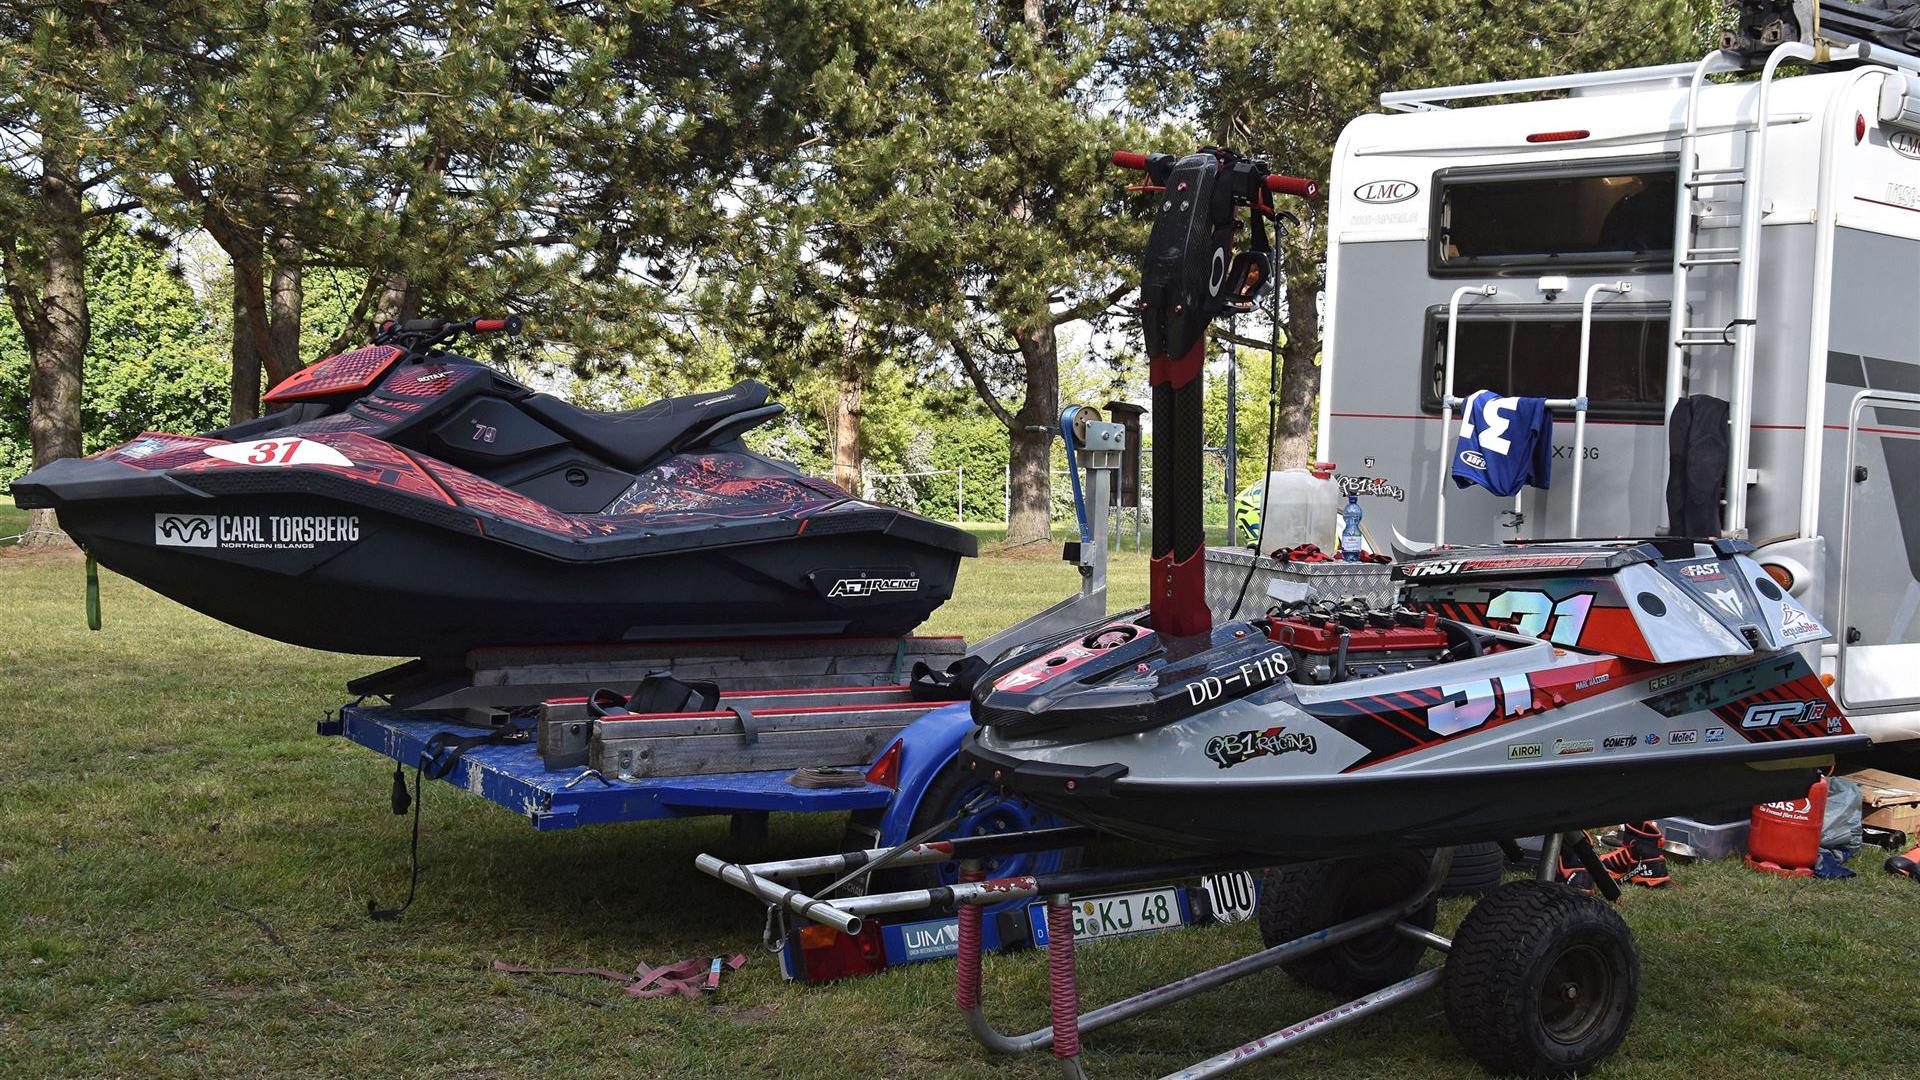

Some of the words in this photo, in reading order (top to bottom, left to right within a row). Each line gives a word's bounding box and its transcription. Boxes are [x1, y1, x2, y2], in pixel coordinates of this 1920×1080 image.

[1366, 183, 1406, 199] LMC
[248, 440, 303, 464] 31
[220, 516, 264, 541] CARL
[1688, 563, 1721, 576] FAST
[872, 579, 919, 591] RACING
[1186, 652, 1288, 706] DD-F118
[1603, 735, 1637, 748] COMETIC
[1510, 745, 1541, 758] AIROH
[1100, 899, 1133, 931] KJ
[1141, 894, 1170, 926] 48
[906, 928, 944, 949] UIM
